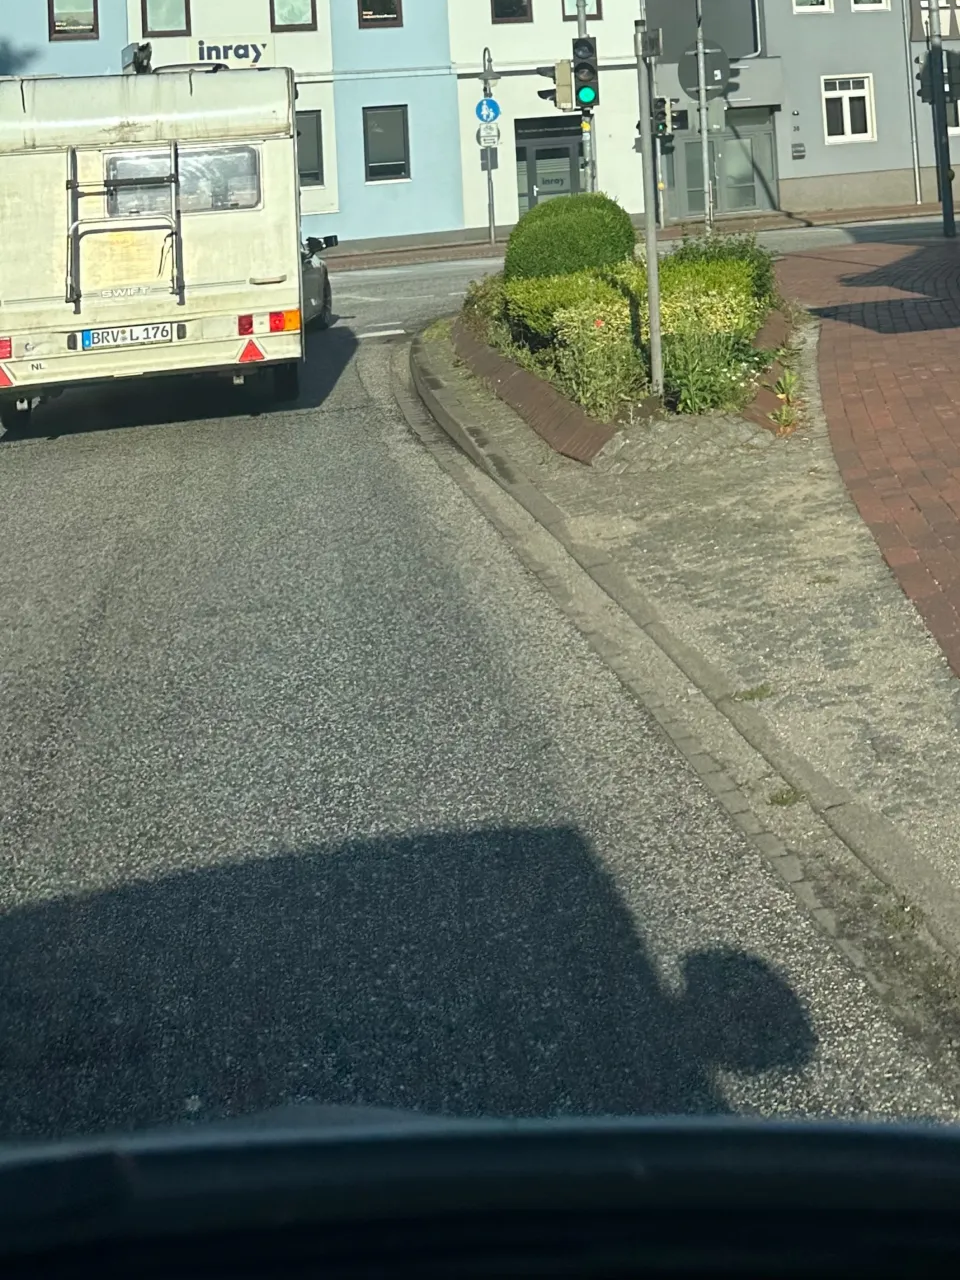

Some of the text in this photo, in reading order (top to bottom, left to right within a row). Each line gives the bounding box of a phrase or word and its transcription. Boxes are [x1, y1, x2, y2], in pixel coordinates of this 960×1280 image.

[197, 39, 268, 64] inray
[101, 286, 150, 298] SWIFT
[91, 329, 121, 345] BRV
[143, 324, 170, 340] 176
[31, 362, 46, 371] NL
